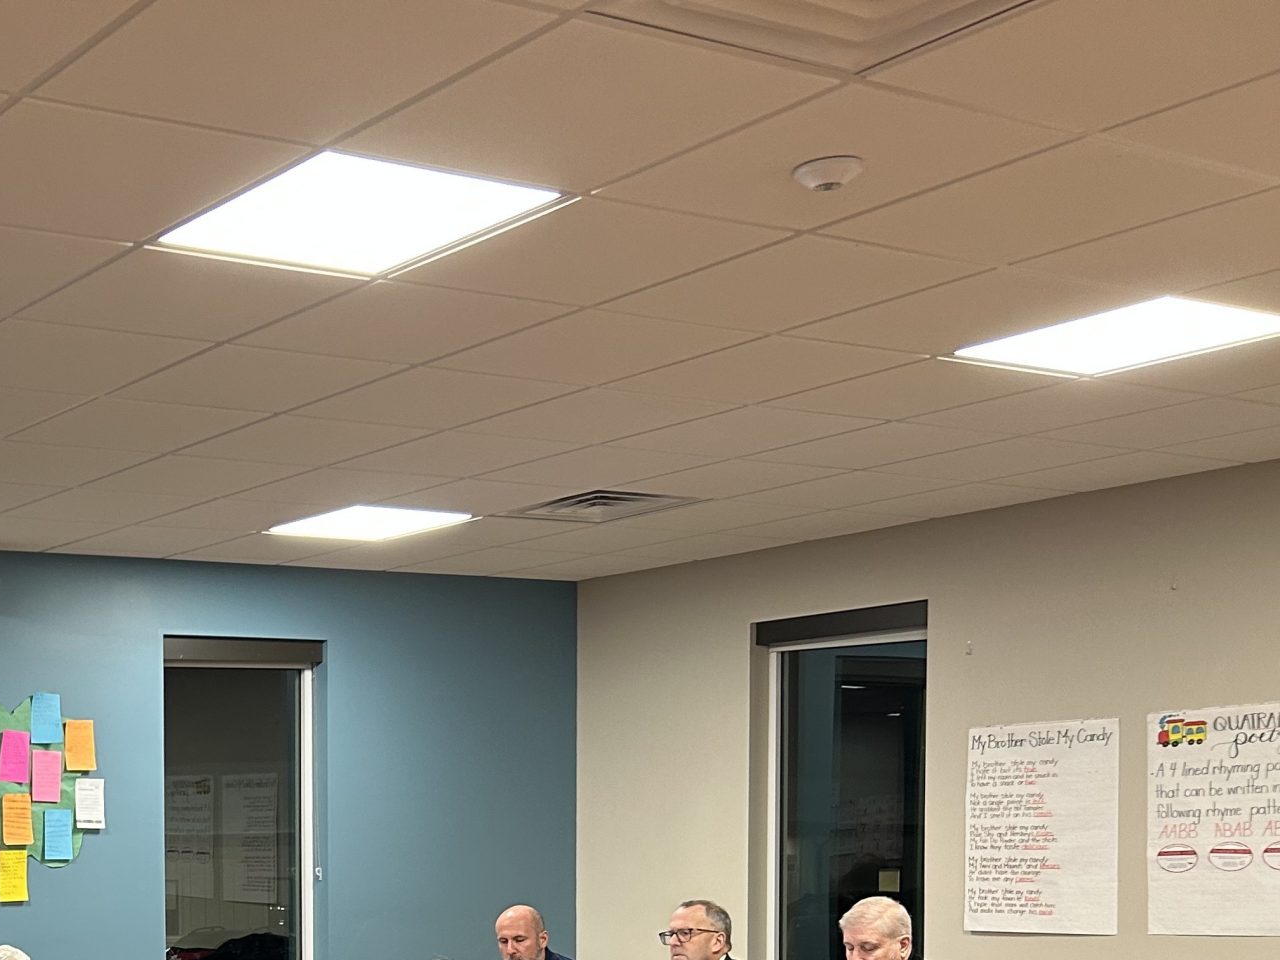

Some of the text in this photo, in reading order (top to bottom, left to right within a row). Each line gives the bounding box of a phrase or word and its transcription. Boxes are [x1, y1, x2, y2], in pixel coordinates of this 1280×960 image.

[971, 727, 1113, 755] My Brother Stole My Candy
[1211, 728, 1280, 759] poet
[1039, 757, 1059, 766] candy
[1169, 762, 1177, 777] 4
[1181, 760, 1211, 776] lined
[1212, 759, 1261, 782] rhyming
[1155, 783, 1179, 798] that
[1183, 788, 1205, 798] can
[1209, 781, 1223, 796] be
[1227, 777, 1269, 795] written
[1156, 803, 1200, 825] following
[1206, 802, 1242, 821] rhyme
[1158, 823, 1198, 839] AABB
[1215, 822, 1253, 837] ABAB
